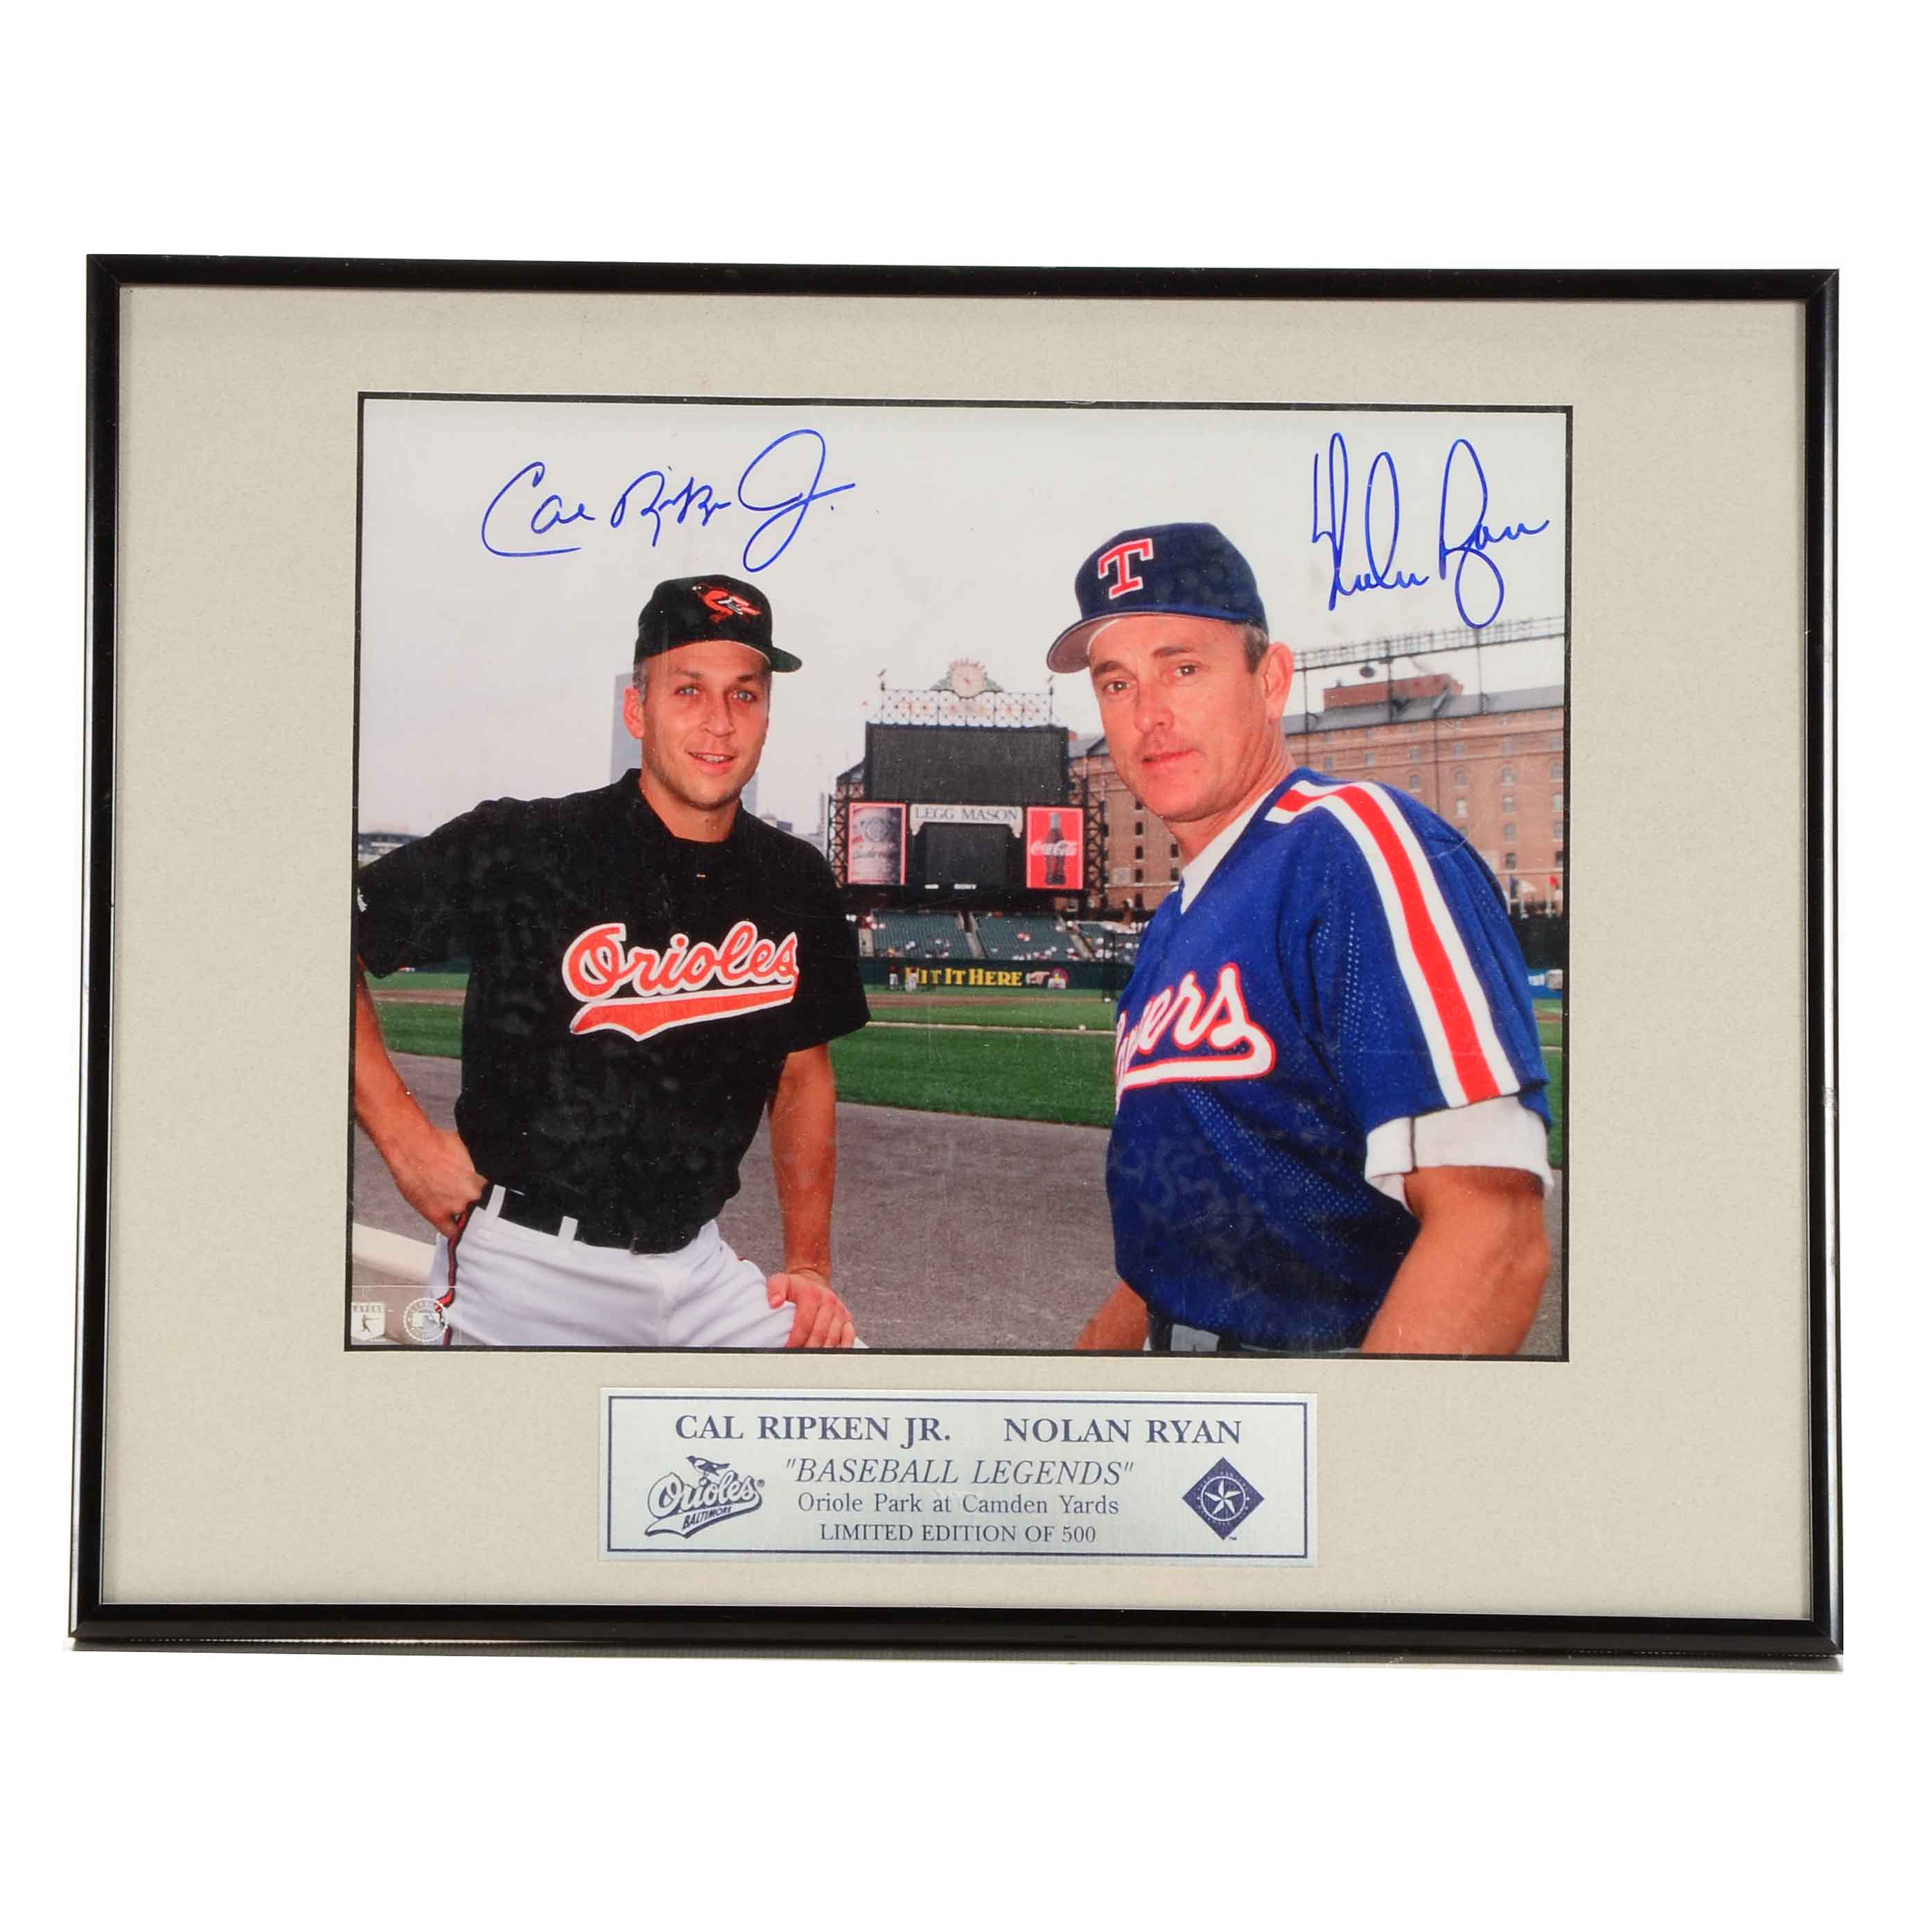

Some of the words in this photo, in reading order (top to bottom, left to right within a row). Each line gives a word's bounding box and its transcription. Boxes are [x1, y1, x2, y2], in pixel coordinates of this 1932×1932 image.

[1098, 538, 1154, 600] T
[915, 807, 954, 819] LEGG
[961, 809, 1018, 820] MASON
[562, 920, 800, 1003] Orioles
[945, 967, 966, 985] IT
[969, 968, 1023, 986] HERE
[676, 1415, 744, 1439] CAL
[759, 1416, 889, 1440] RIPKEN
[900, 1418, 951, 1449] JR.
[1004, 1419, 1130, 1442] NOLAN
[1146, 1420, 1240, 1443] RYAN
[786, 1459, 959, 1484] "BASEBALL
[972, 1460, 1134, 1486] LEGENDS"
[798, 1493, 863, 1512] Oriole
[875, 1493, 922, 1513] Park
[933, 1497, 950, 1513] at
[962, 1494, 1047, 1513] Camden
[1060, 1495, 1119, 1514] Yards
[820, 1523, 913, 1540] LIMITED
[922, 1525, 1017, 1542] EDITION
[1025, 1526, 1054, 1542] OF
[1062, 1526, 1096, 1542] 500
